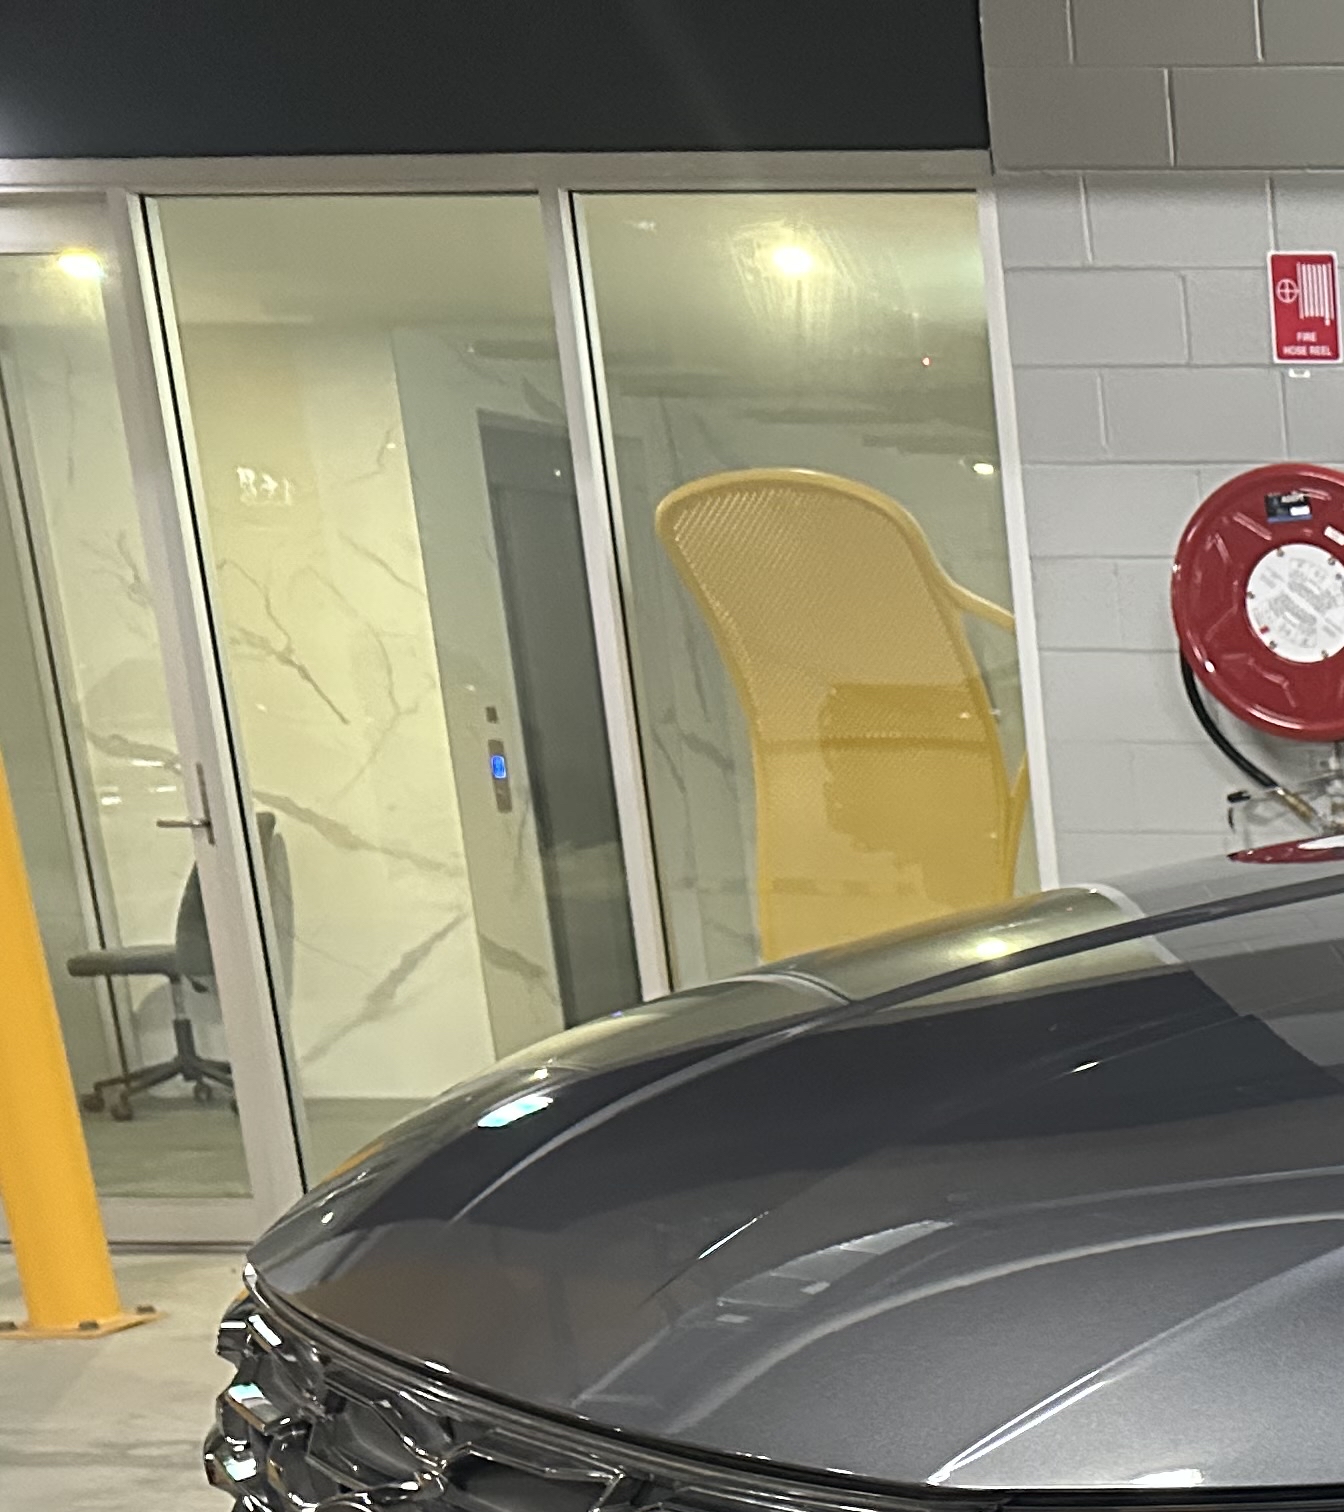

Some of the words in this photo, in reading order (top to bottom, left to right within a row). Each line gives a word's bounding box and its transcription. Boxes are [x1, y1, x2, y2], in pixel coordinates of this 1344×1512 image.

[1296, 331, 1317, 343] FIRE
[1283, 345, 1307, 356] HOSE
[1309, 345, 1332, 357] REEL
